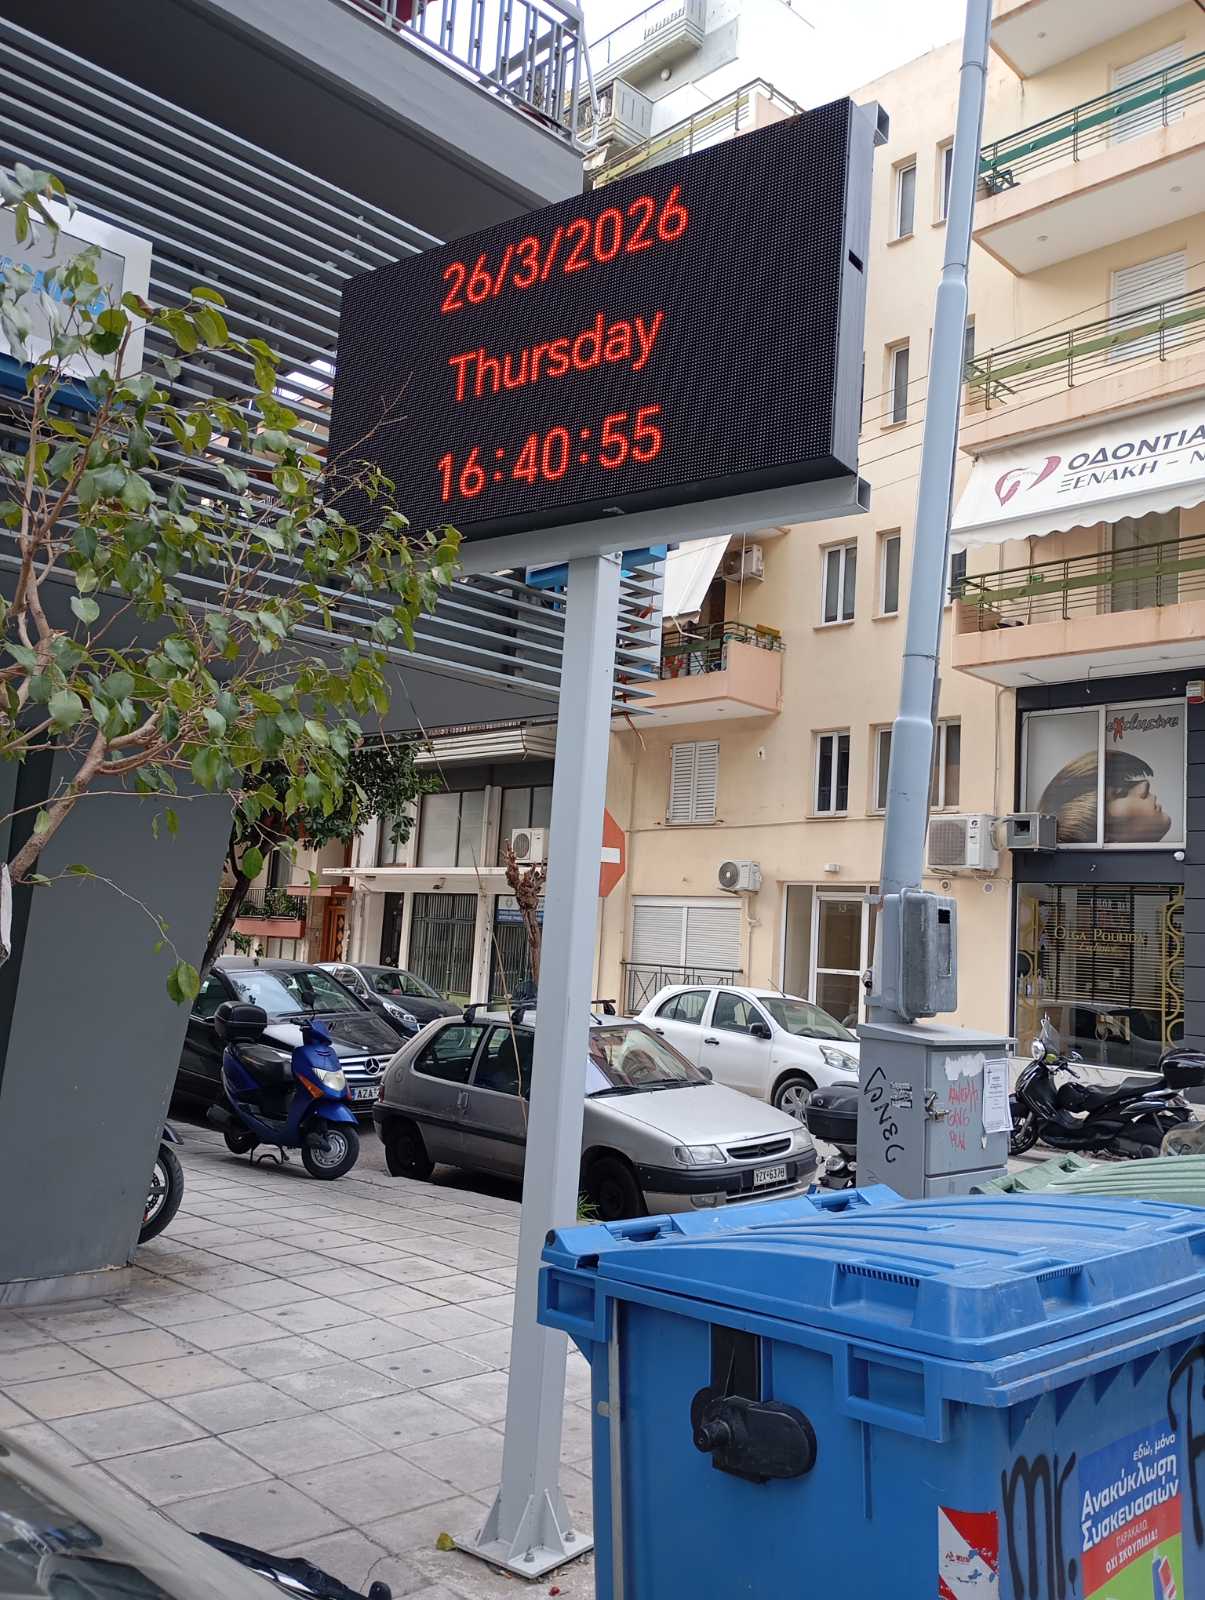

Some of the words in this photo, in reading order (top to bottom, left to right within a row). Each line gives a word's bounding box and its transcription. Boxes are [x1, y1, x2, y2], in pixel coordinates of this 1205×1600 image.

[440, 184, 690, 314] 26/3/2026
[448, 309, 665, 403] Thursday
[437, 403, 664, 502] 16:40:55
[1057, 460, 1158, 493] ΞΕΝΑΚΗ
[1154, 1433, 1176, 1455] μόνο
[1081, 1454, 1177, 1522] Ανακύκλωση
[1081, 1476, 1179, 1552] Συσκευασιών
[1106, 1558, 1118, 1574] ΟΧΙ
[1119, 1529, 1159, 1564] ΣΚΟΥΠΙΔΙΑ!
